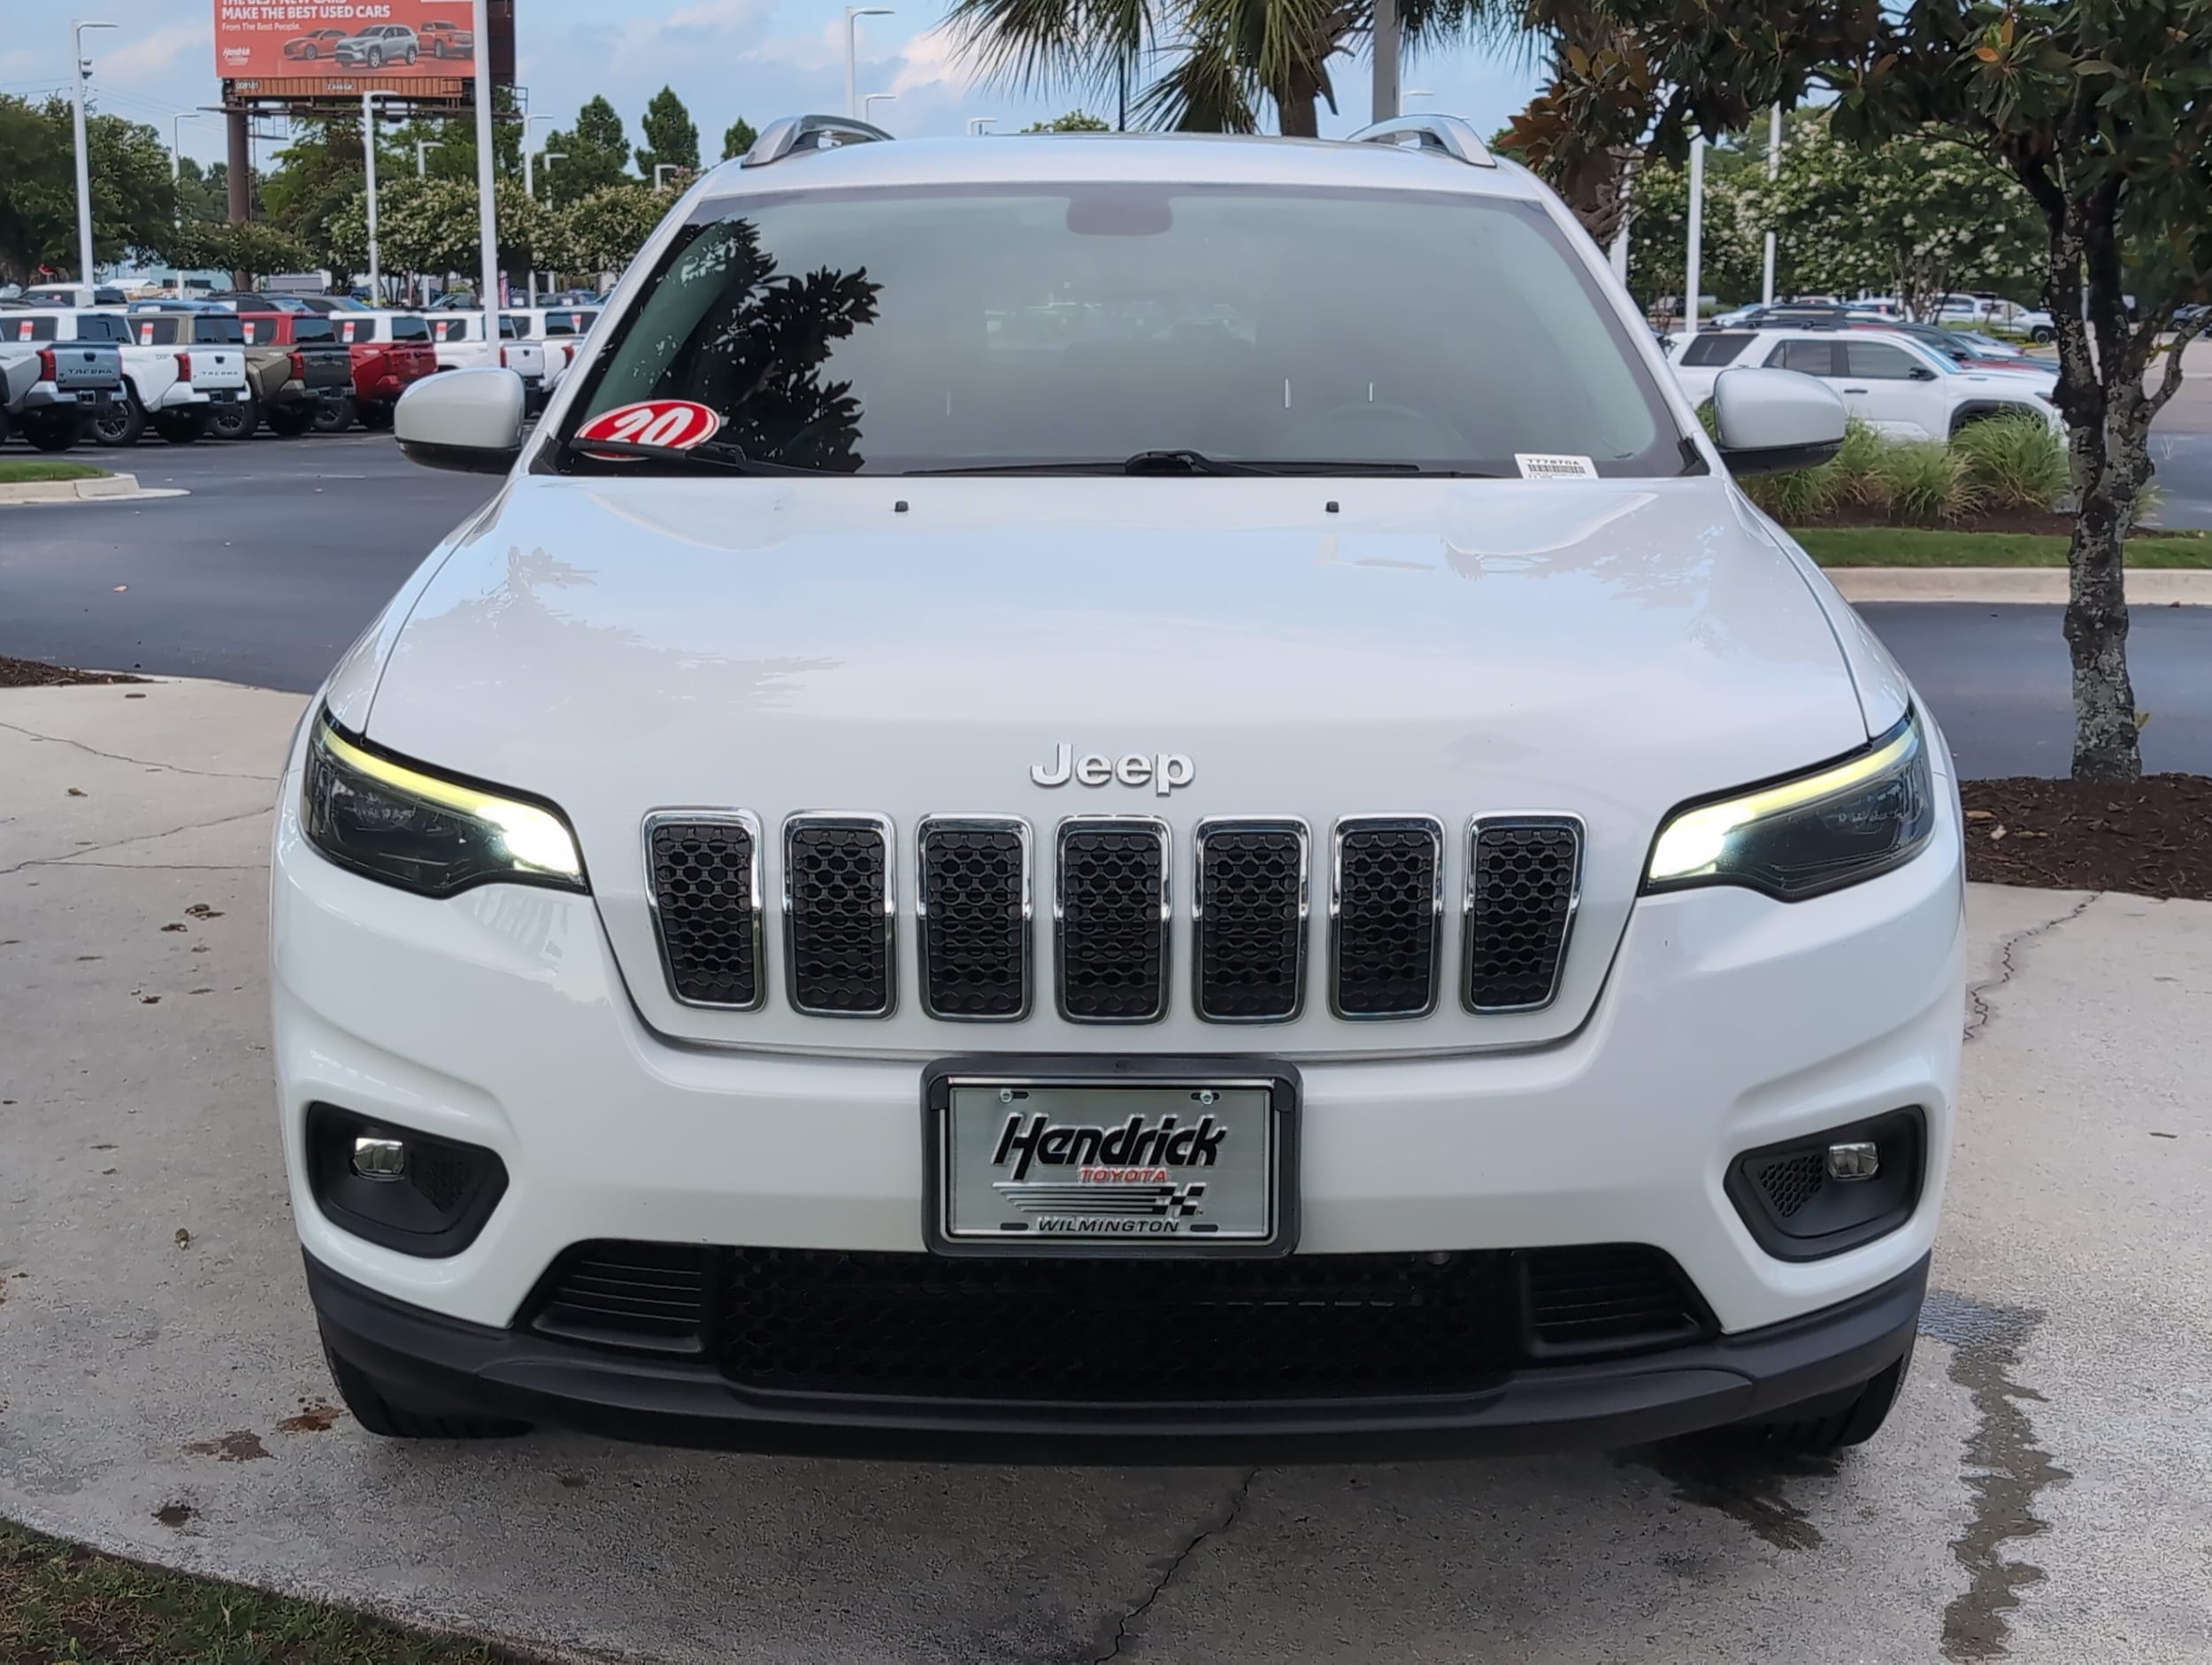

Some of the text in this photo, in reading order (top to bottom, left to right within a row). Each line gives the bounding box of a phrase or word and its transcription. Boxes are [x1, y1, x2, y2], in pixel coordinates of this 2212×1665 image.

[222, 4, 391, 19] MAKE THE BEST USED CARS
[222, 22, 241, 31] From
[242, 22, 256, 31] The
[606, 407, 695, 445] 20
[1030, 742, 1194, 797] Jeep
[990, 1112, 1227, 1181] Hendrick
[1079, 1167, 1168, 1183] TOYOTA
[1037, 1216, 1181, 1232] WILMINGTON
